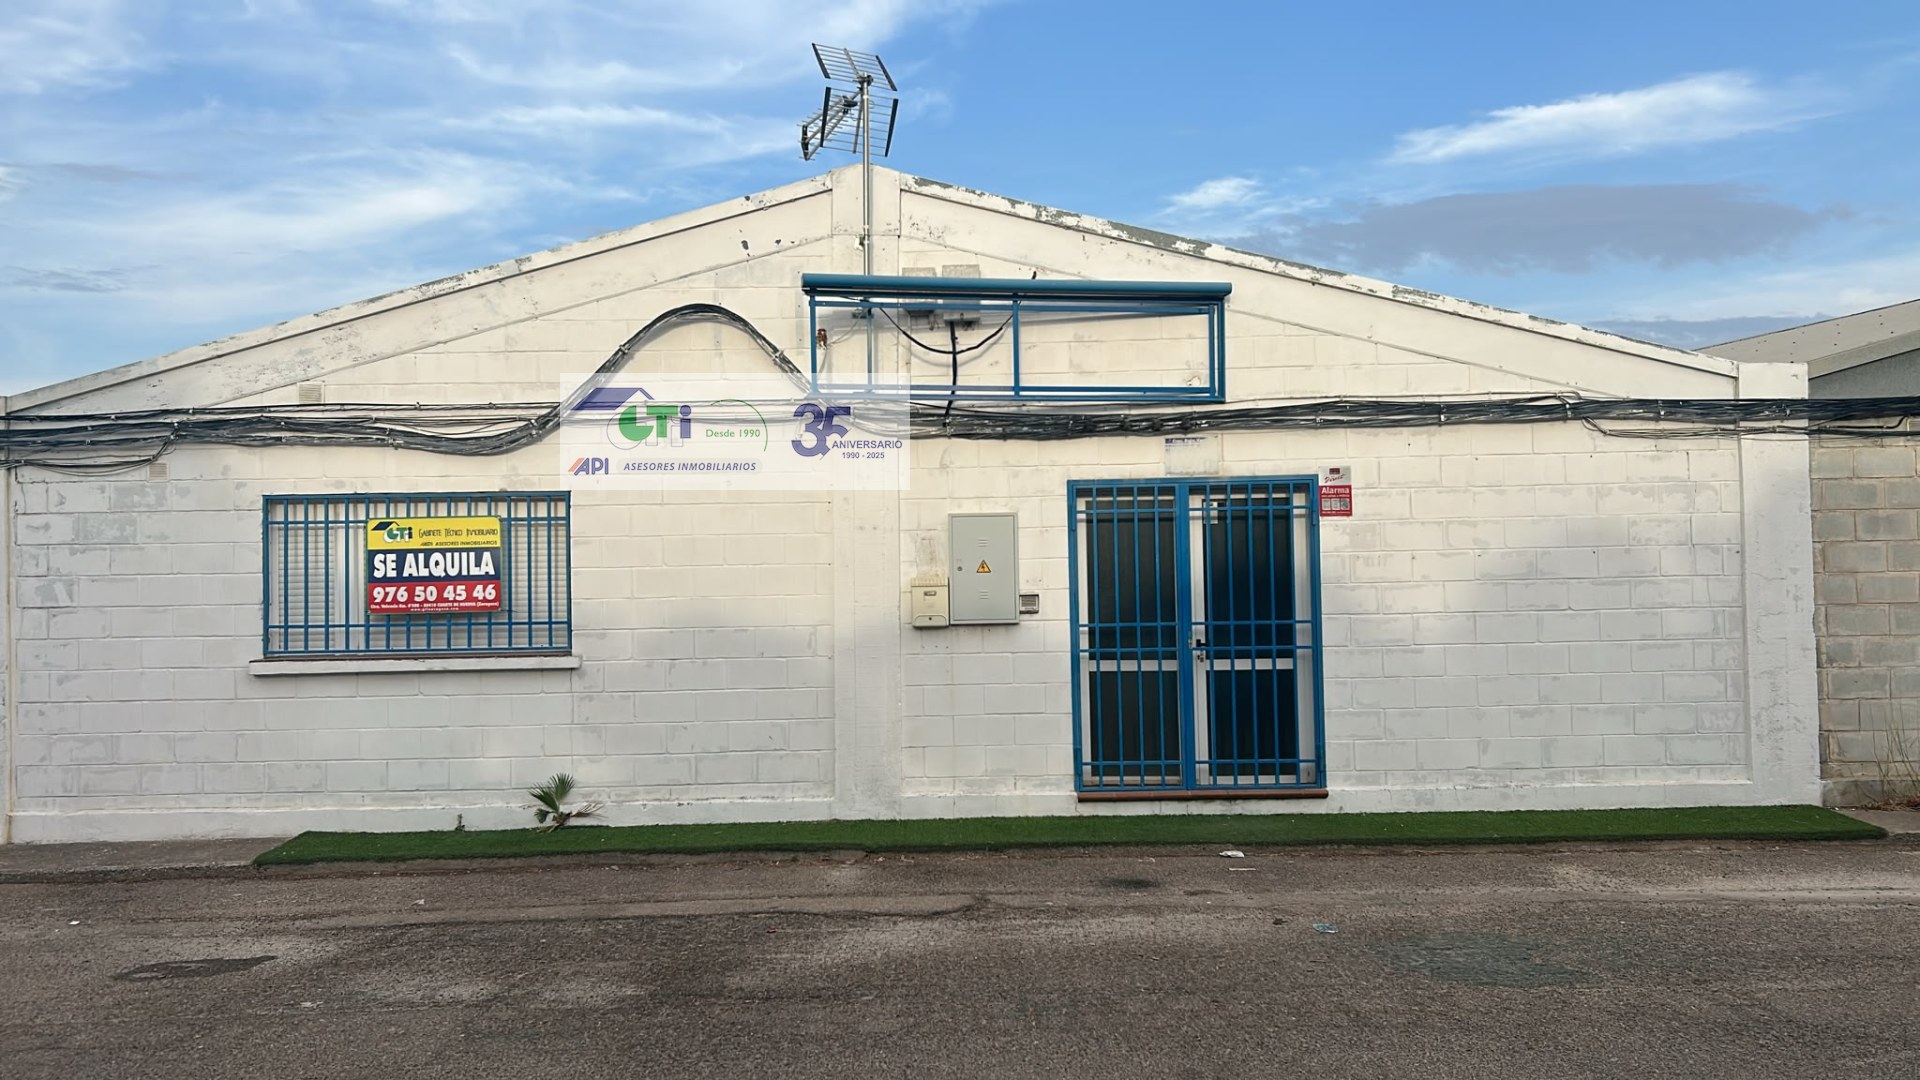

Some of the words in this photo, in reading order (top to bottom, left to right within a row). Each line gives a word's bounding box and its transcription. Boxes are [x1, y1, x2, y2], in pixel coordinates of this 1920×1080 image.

[1321, 486, 1350, 495] Alarma
[373, 553, 397, 578] SE
[402, 551, 496, 577] ALQUILA
[373, 586, 408, 603] 976
[414, 585, 437, 602] 50
[443, 585, 467, 601] 45
[472, 584, 496, 600] 46
